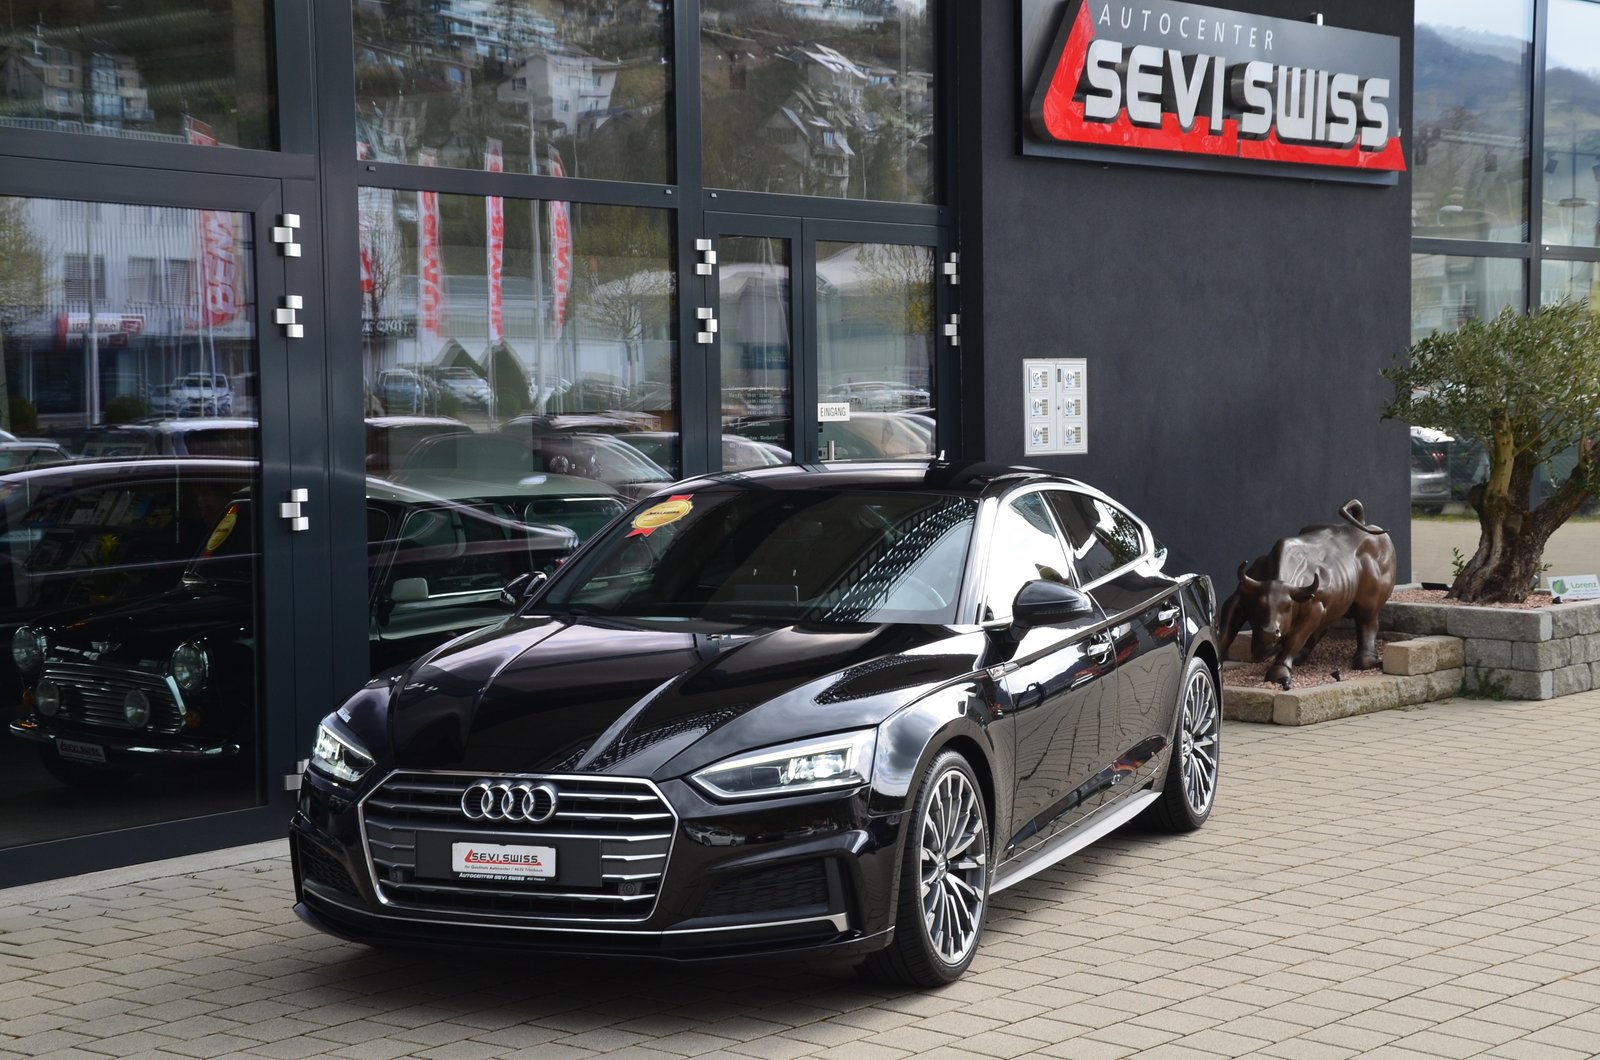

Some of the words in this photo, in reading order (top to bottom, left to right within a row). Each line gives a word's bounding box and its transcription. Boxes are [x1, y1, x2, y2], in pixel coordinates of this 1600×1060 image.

[1098, 3, 1274, 51] AUTOCENTER
[1084, 39, 1226, 131] SEVI
[1241, 60, 1390, 147] SWISS
[820, 406, 847, 417] EINGANG
[472, 852, 500, 862] SEVI
[502, 854, 538, 863] SWISS
